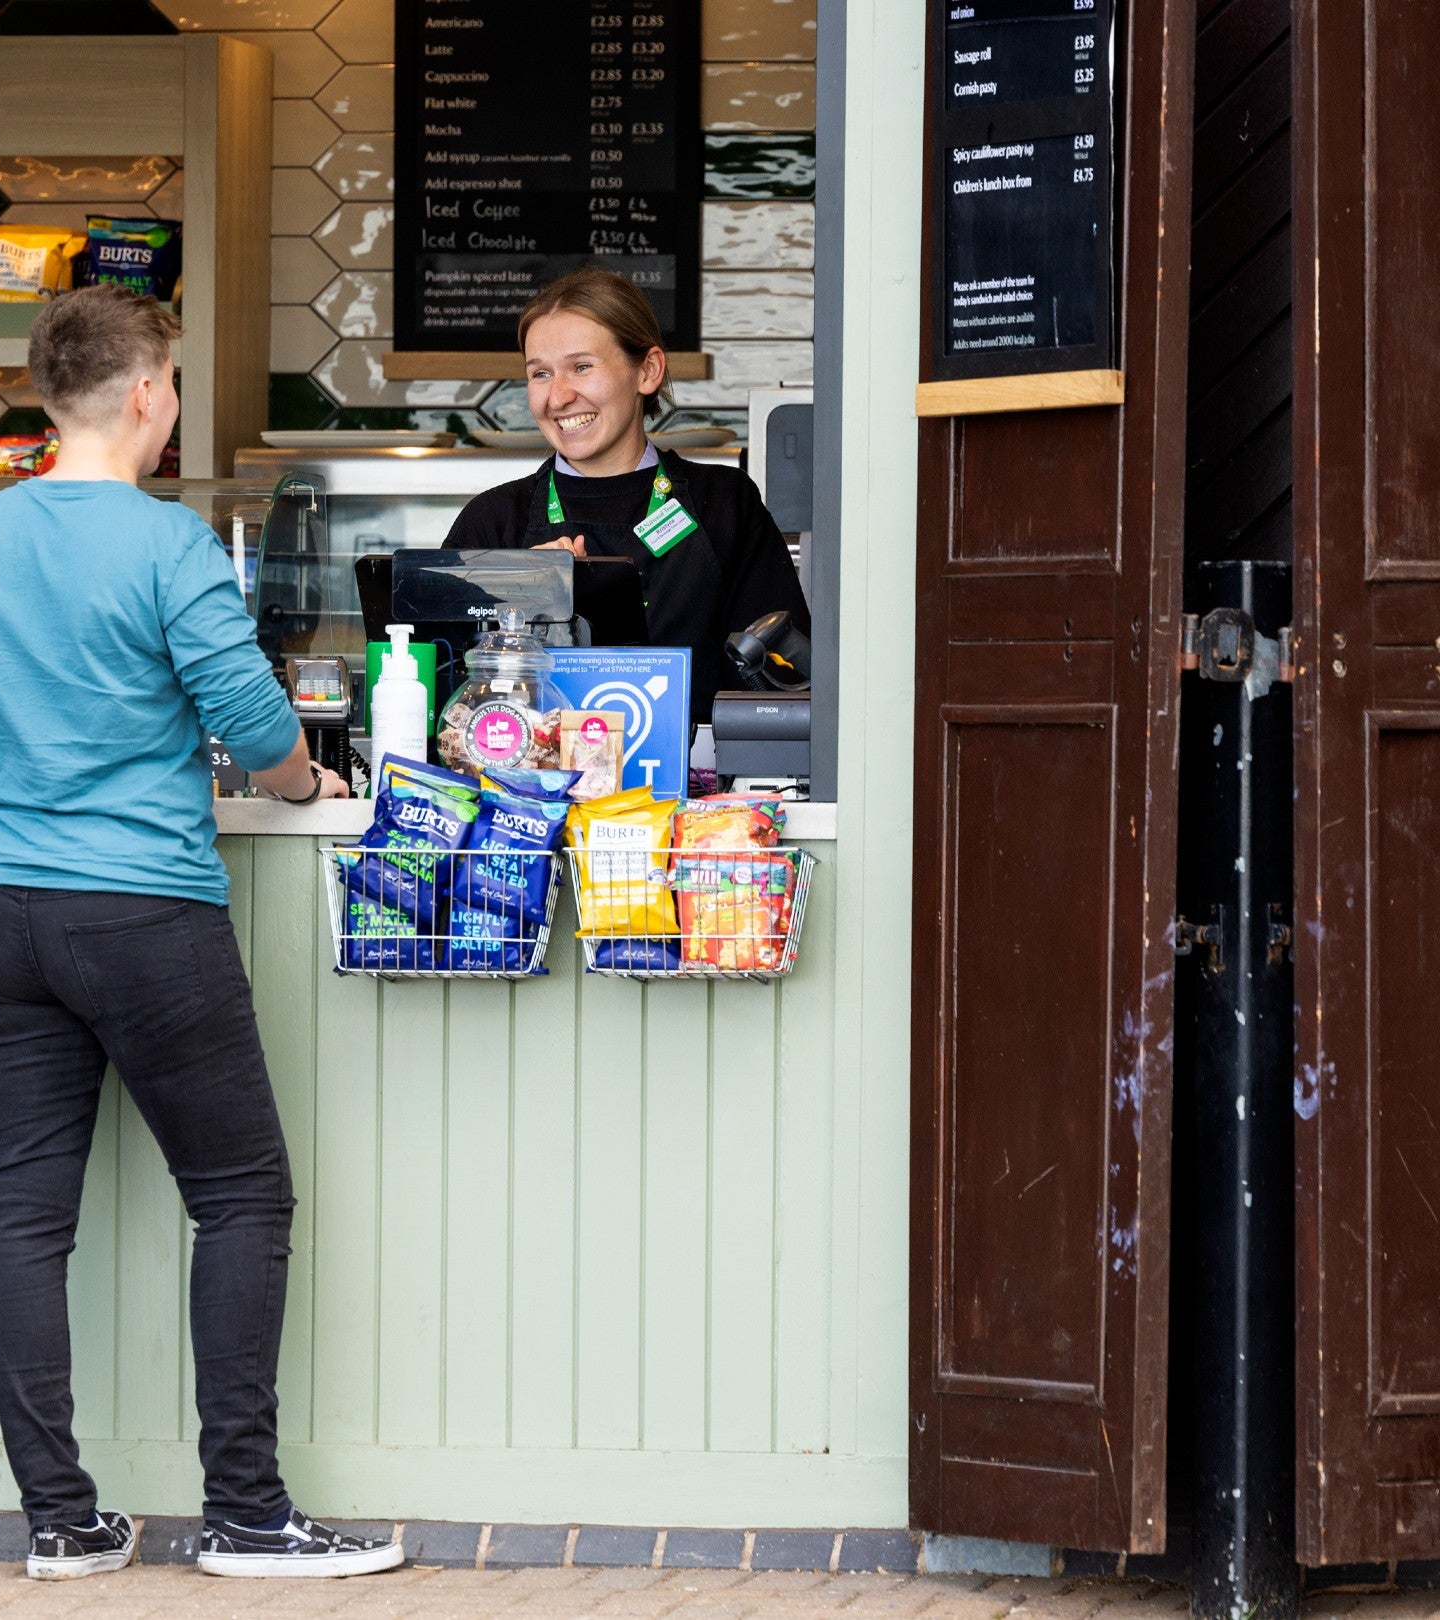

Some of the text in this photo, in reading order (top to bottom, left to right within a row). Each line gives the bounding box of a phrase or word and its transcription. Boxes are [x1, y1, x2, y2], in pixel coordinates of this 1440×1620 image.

[425, 17, 484, 30] Americano
[1074, 34, 1095, 50] £3.95
[425, 44, 454, 56] Latte
[954, 46, 992, 65] Sausage roll
[425, 71, 489, 83] Cappuccino
[953, 80, 997, 97] Cornish pasty
[425, 98, 477, 110] Flat white
[425, 124, 462, 136] Mocha
[425, 150, 447, 162] Add
[448, 152, 480, 165] syrup
[953, 144, 1024, 164] Spicy cauliflower pasty
[425, 177, 521, 192] Add espresso shot
[953, 174, 1032, 195] Children's lunch box from
[472, 198, 521, 222] Coffee
[421, 228, 537, 251] Iced Chocolate
[99, 246, 153, 263] BURTS
[425, 271, 533, 284] Pumpkin spiced latte
[998, 335, 1014, 346] 2000
[467, 605, 498, 617] digipos
[578, 656, 601, 666] hearing
[602, 657, 617, 666] loop
[617, 656, 637, 666] facility
[637, 656, 657, 664] switch
[657, 658, 672, 666] your
[756, 706, 779, 714] EPSON
[469, 705, 529, 748] ANGUS THE DOG APPROVED
[468, 744, 486, 762] MADE
[483, 758, 491, 766] IN
[504, 757, 515, 766] UK
[399, 803, 459, 836] BURTS
[492, 808, 549, 837] BURTS
[596, 825, 646, 838] BURTS
[491, 855, 518, 874] SEA
[475, 863, 528, 889] SALTED
[350, 902, 376, 915] SEA
[370, 915, 410, 927] MALT
[451, 911, 509, 927] LIGHTLY
[463, 925, 491, 938] SEA
[451, 938, 502, 951] SALTED
